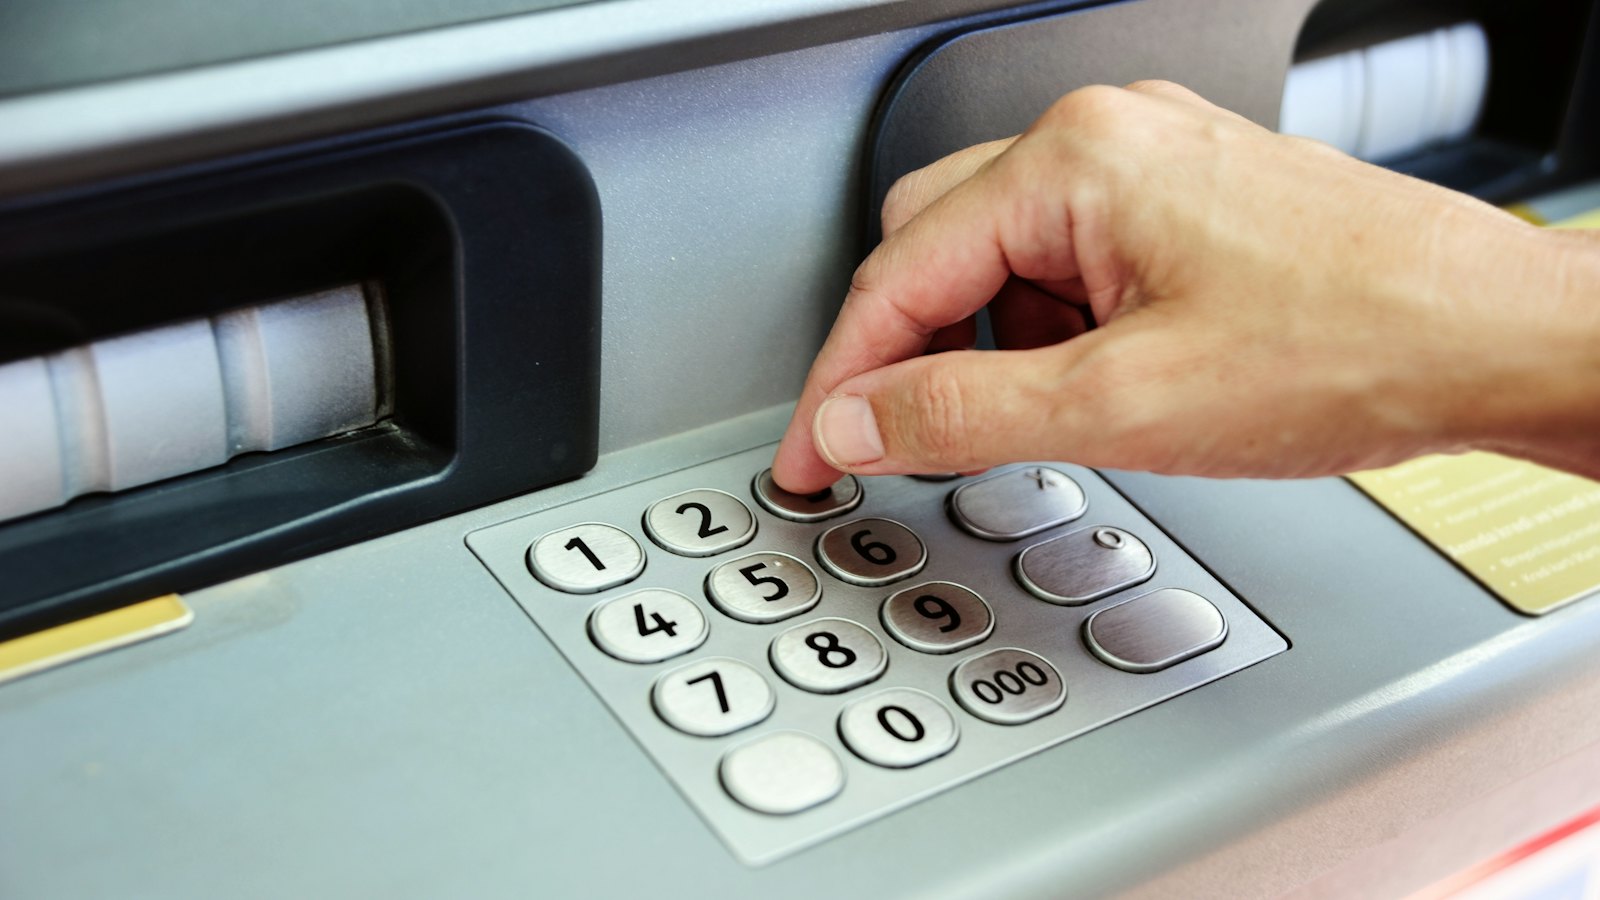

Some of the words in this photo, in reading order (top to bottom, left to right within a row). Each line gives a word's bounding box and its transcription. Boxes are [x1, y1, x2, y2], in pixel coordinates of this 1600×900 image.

[674, 502, 729, 539] 2
[563, 536, 607, 571] 1
[850, 529, 897, 566] 6
[738, 562, 790, 602] 5
[634, 603, 678, 638] 4
[913, 594, 962, 633] 9
[804, 631, 857, 669] 8
[686, 671, 730, 714] 7
[970, 660, 1049, 705] 000
[876, 704, 926, 742] 0
